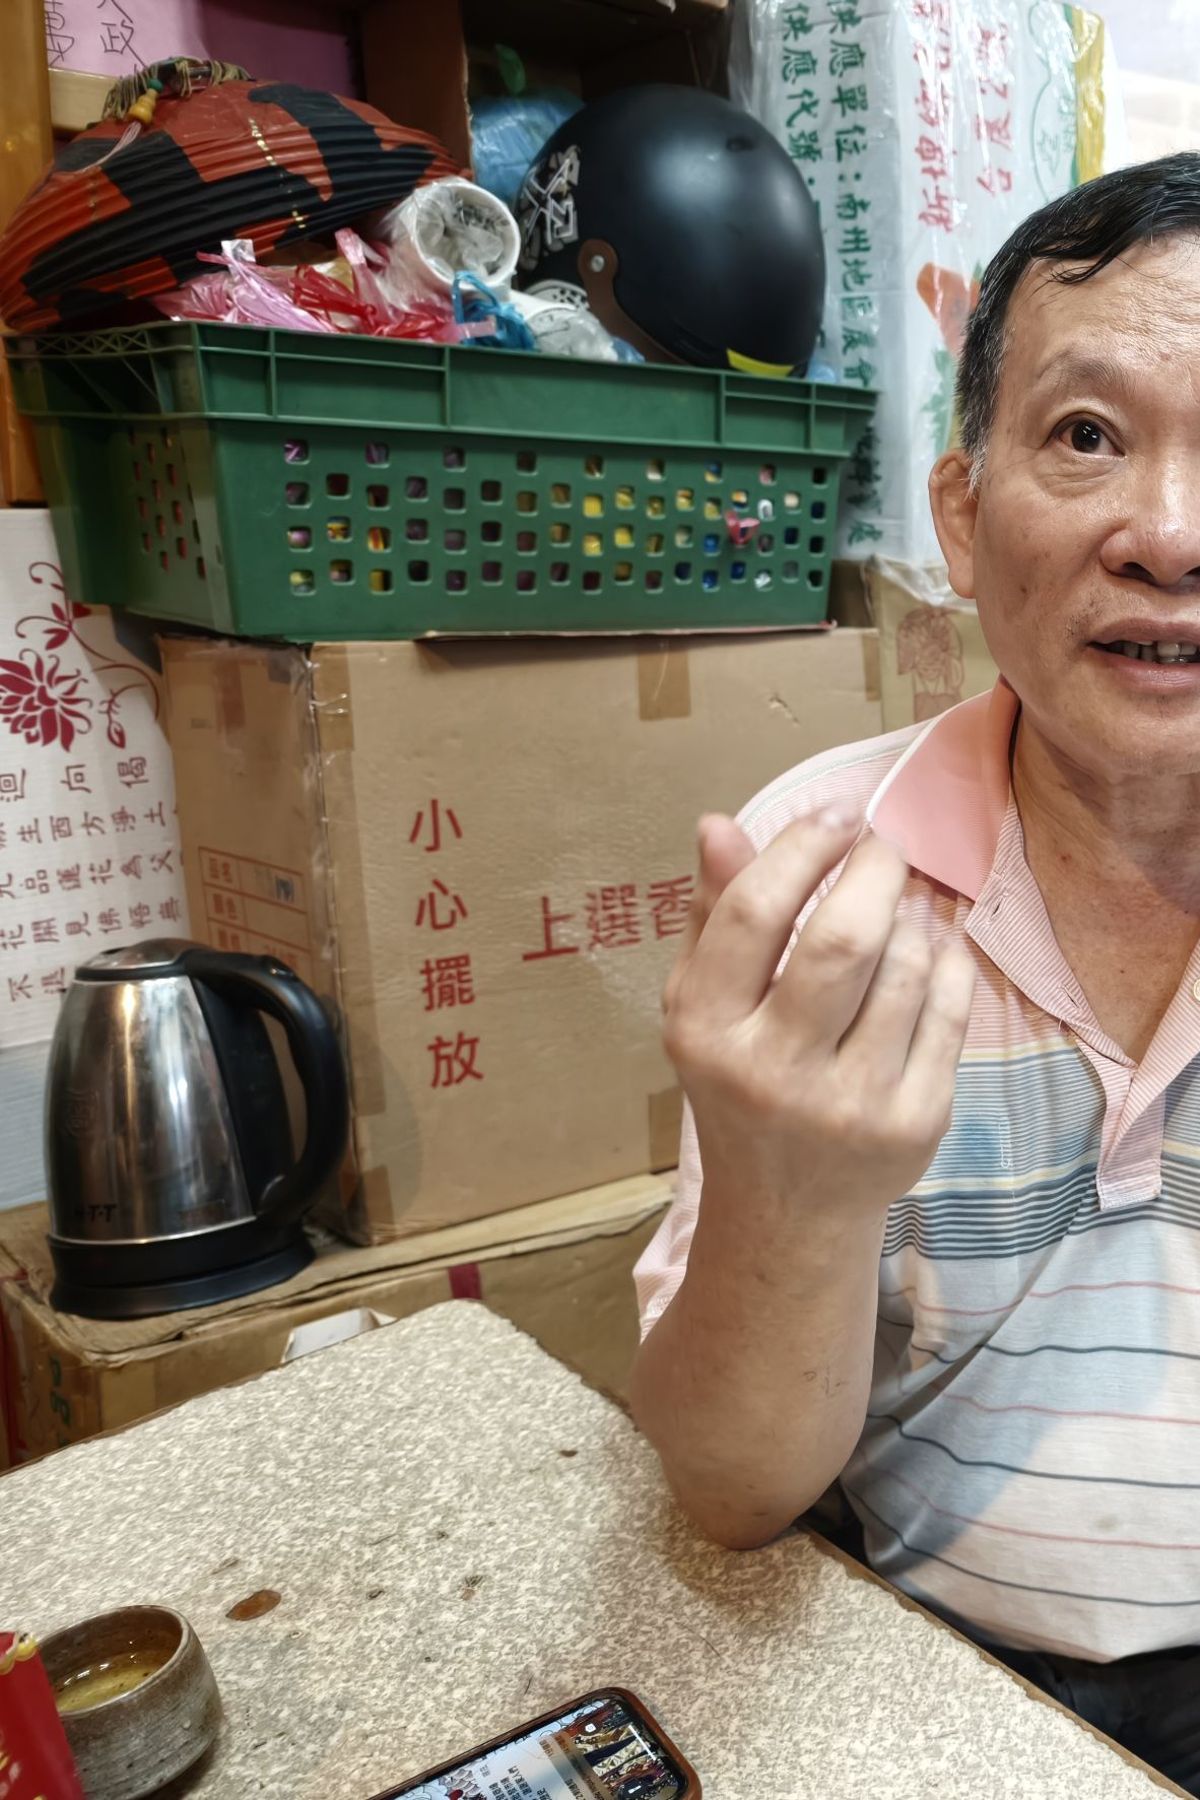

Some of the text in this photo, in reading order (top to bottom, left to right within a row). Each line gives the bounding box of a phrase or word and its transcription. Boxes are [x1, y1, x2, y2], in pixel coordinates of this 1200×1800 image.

[409, 799, 483, 1088] 小心擺放
[522, 875, 695, 962] 上選香
